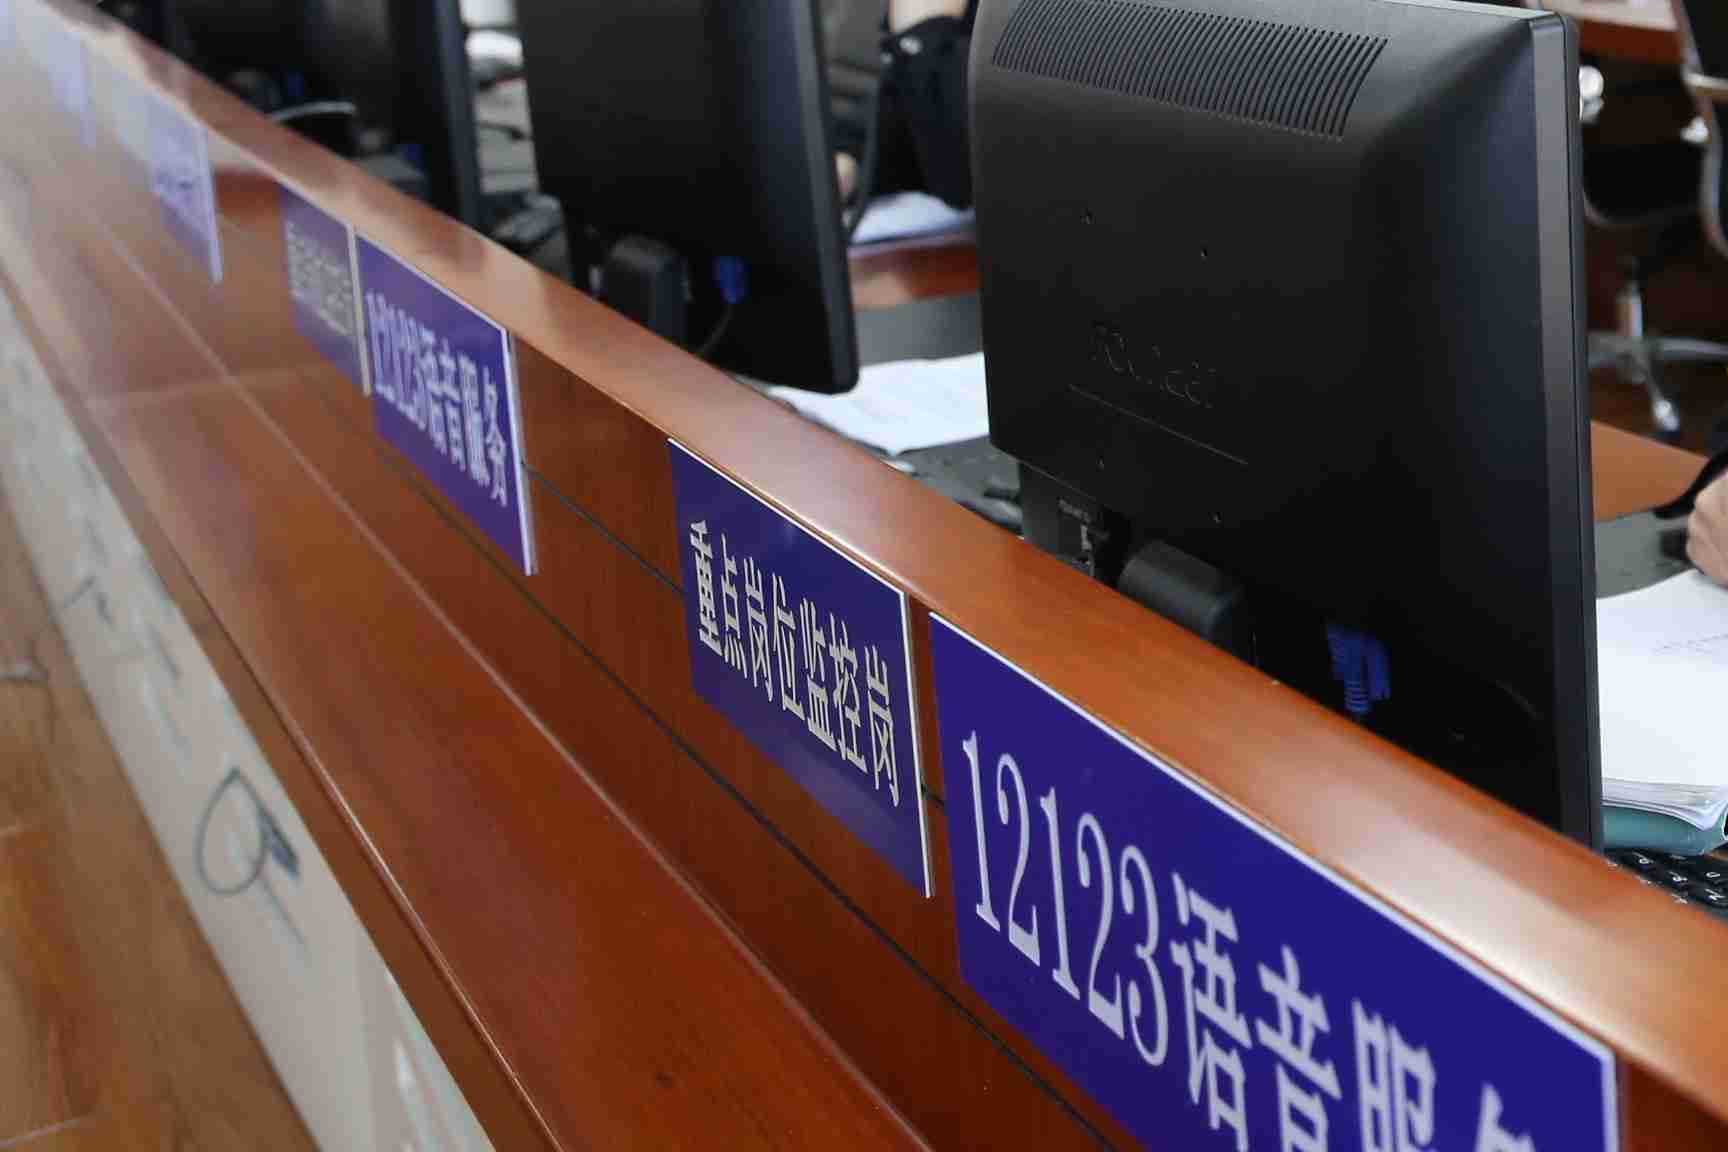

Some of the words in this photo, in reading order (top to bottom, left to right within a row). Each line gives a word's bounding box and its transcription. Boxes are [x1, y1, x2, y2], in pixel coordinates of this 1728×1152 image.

[365, 292, 508, 508] 12123语音服务
[688, 519, 901, 808] 重点岗位监控岗
[962, 729, 1537, 1152] 12123语音服
